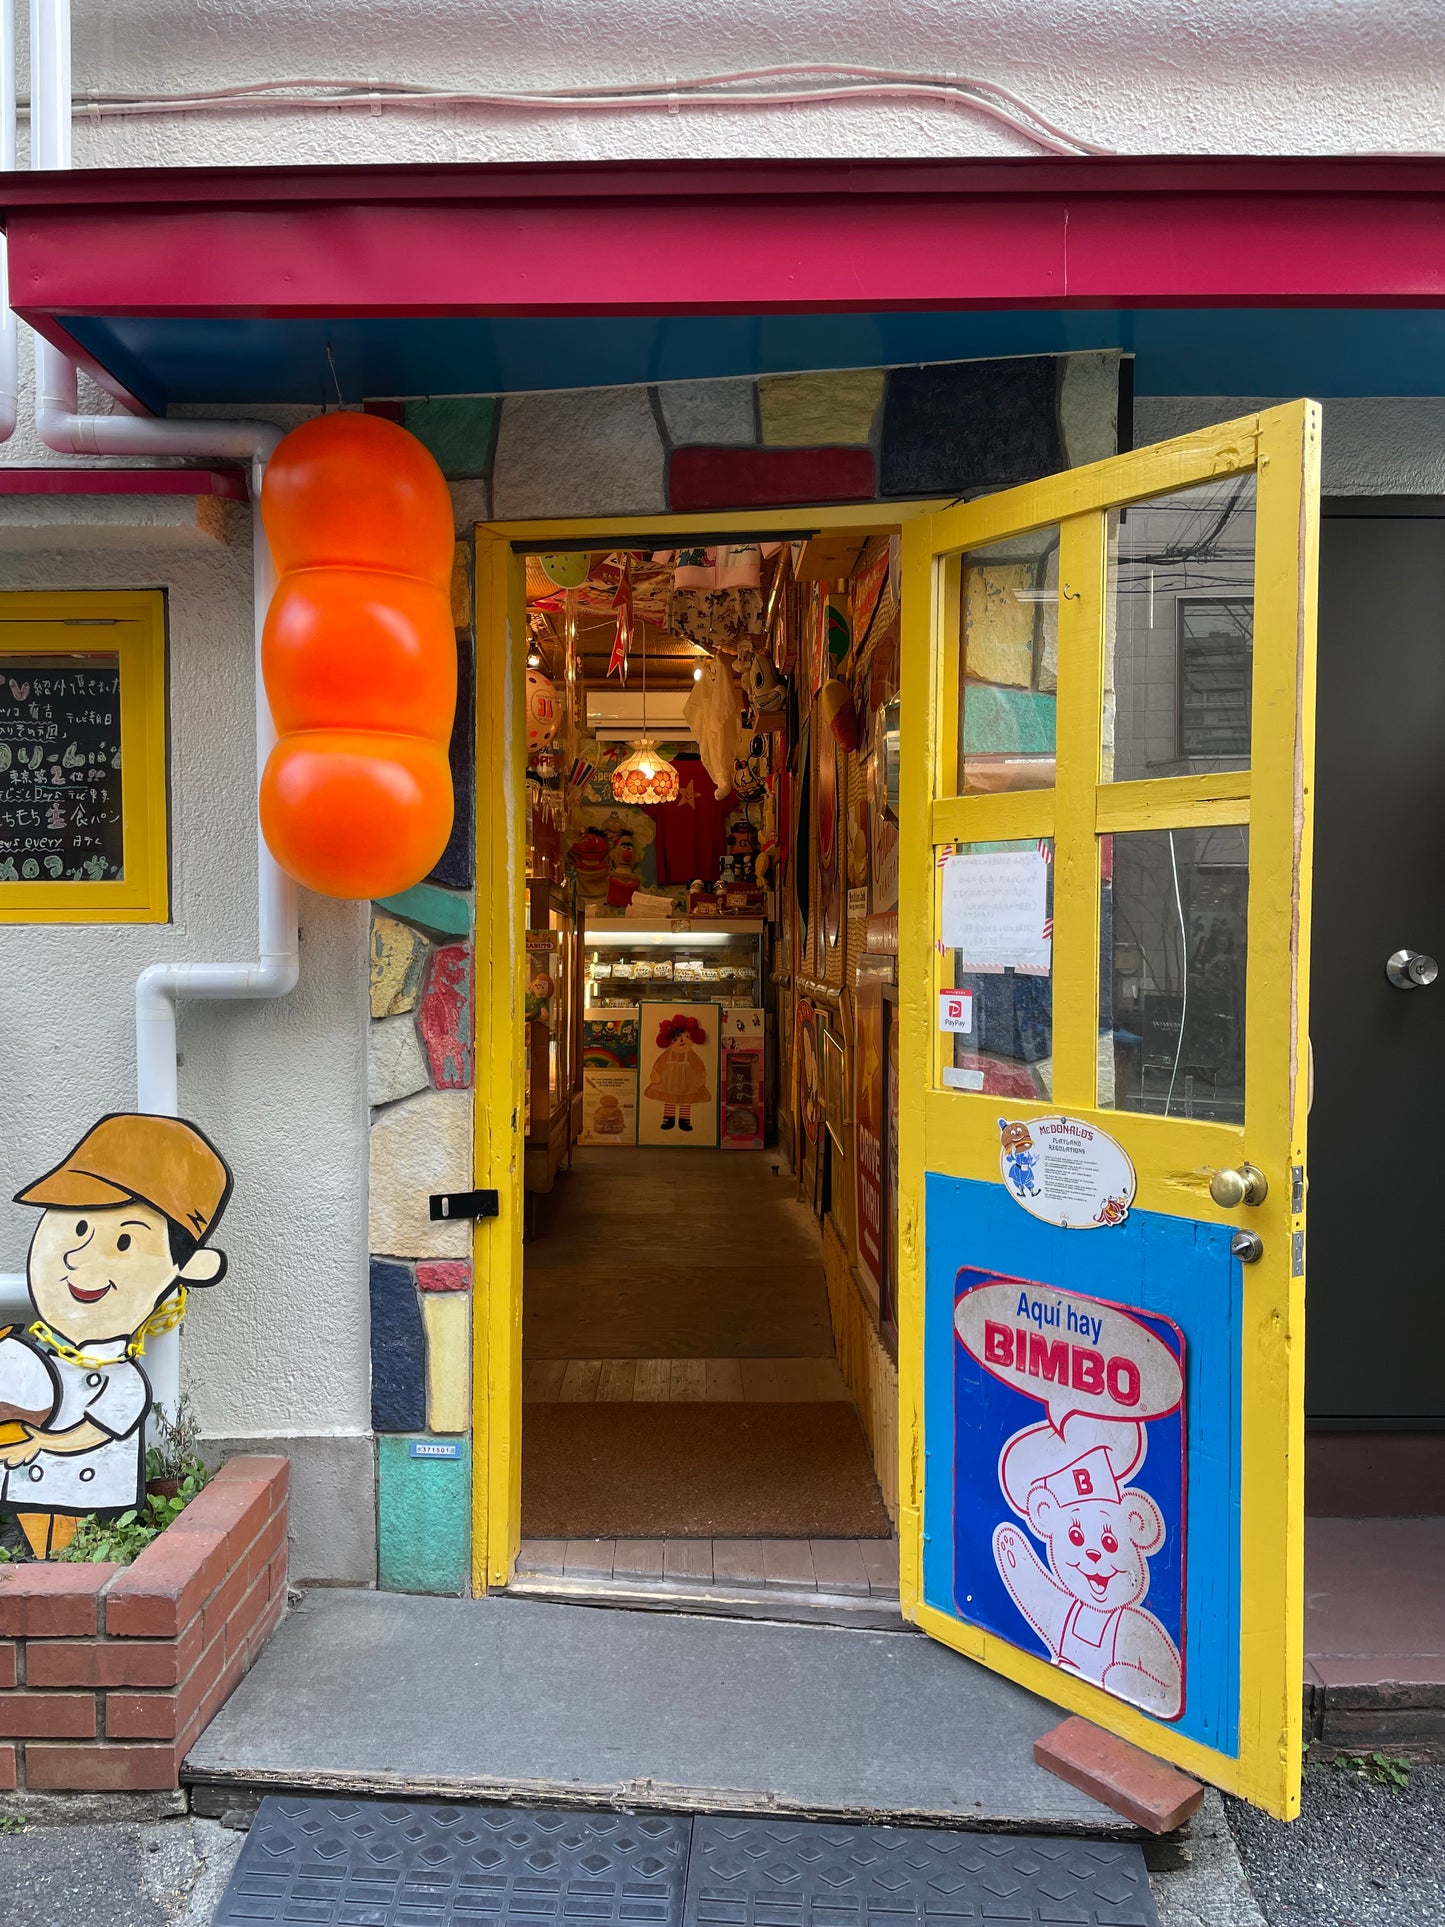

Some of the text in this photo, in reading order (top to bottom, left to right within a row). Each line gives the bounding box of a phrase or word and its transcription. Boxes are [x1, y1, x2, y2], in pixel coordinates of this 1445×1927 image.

[25, 837, 63, 849] every
[944, 1018, 966, 1028] PayPay
[860, 1123, 880, 1183] DRIVE
[860, 1173, 880, 1234] THRU
[1016, 1292, 1103, 1346] Aquí hay
[984, 1319, 1141, 1407] BIMBO
[1071, 1468, 1094, 1496] B
